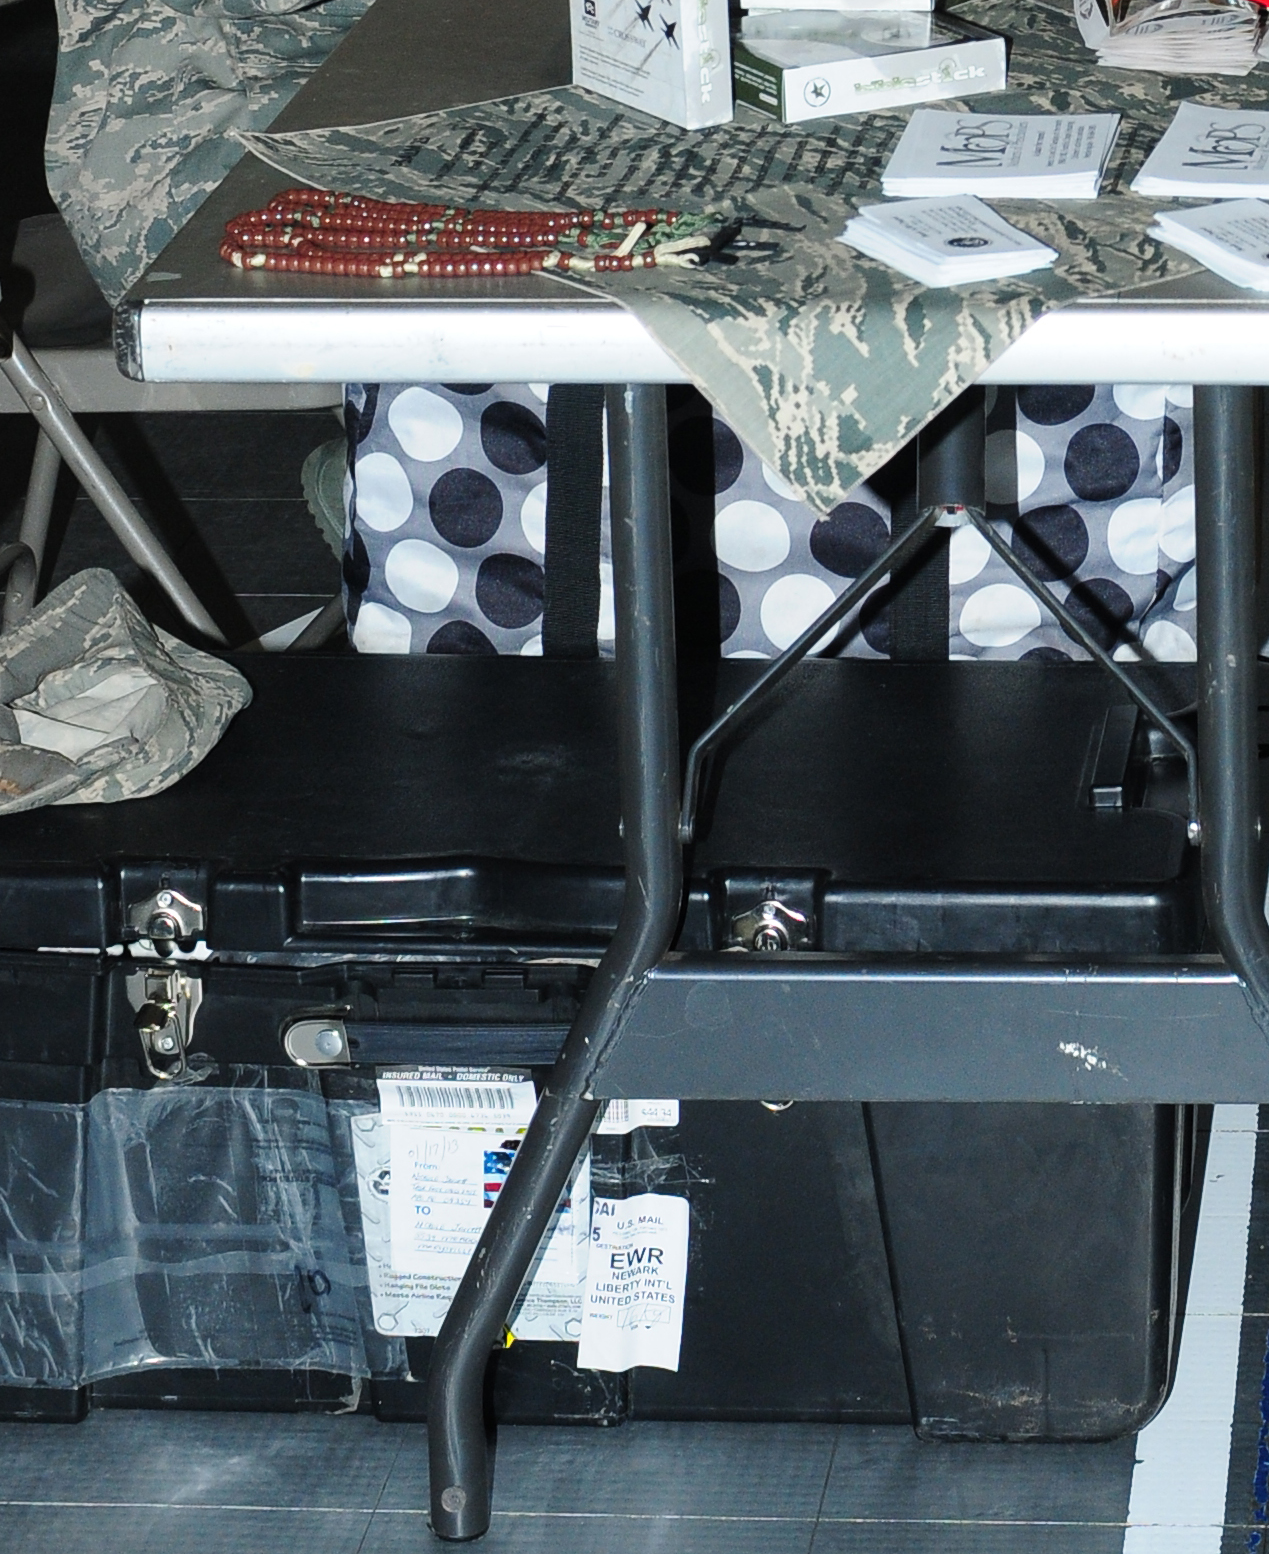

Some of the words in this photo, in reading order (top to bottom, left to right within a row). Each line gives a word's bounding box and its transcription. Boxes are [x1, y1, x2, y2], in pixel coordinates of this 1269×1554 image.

[382, 1072, 421, 1081] INSURED
[422, 1072, 444, 1081] MAIL
[456, 1072, 501, 1082] DOMESTIC
[502, 1073, 525, 1083] ONLY
[415, 1205, 432, 1216] TO
[638, 1215, 664, 1225] MAIL
[610, 1246, 664, 1270] EWR
[611, 1265, 660, 1281] NEWARK
[595, 1278, 642, 1294] LIBERTY
[643, 1278, 673, 1290] INT'L
[590, 1294, 632, 1307] UNITED
[633, 1290, 676, 1304] STATES
